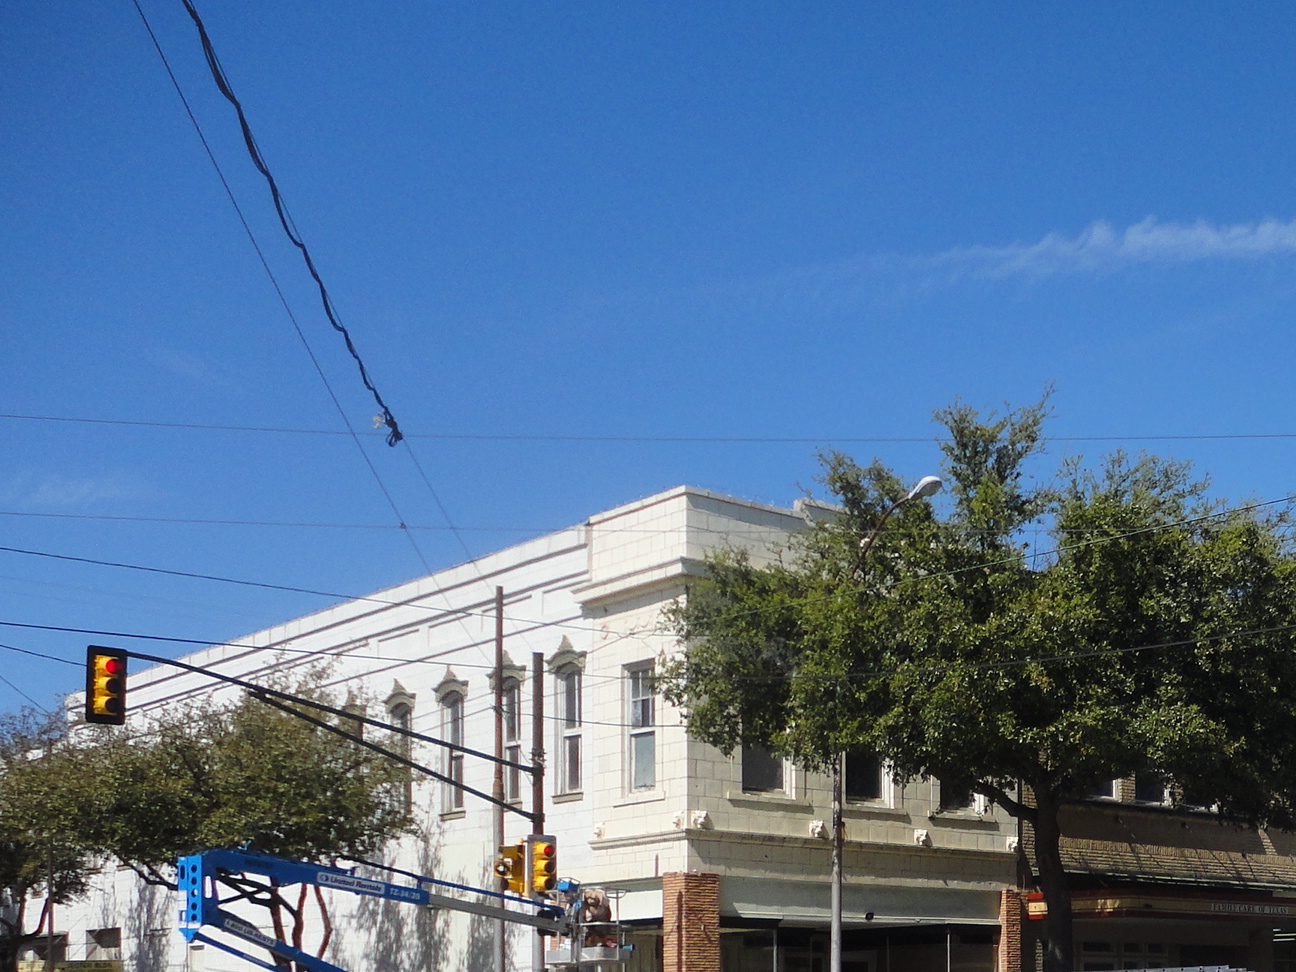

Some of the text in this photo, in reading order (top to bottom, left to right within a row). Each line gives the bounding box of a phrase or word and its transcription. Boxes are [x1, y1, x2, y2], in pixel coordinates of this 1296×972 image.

[330, 876, 382, 893] United Rentals
[1213, 903, 1237, 912] FAMILY
[1238, 904, 1255, 913] CARE
[1268, 906, 1288, 914] TEXAS
